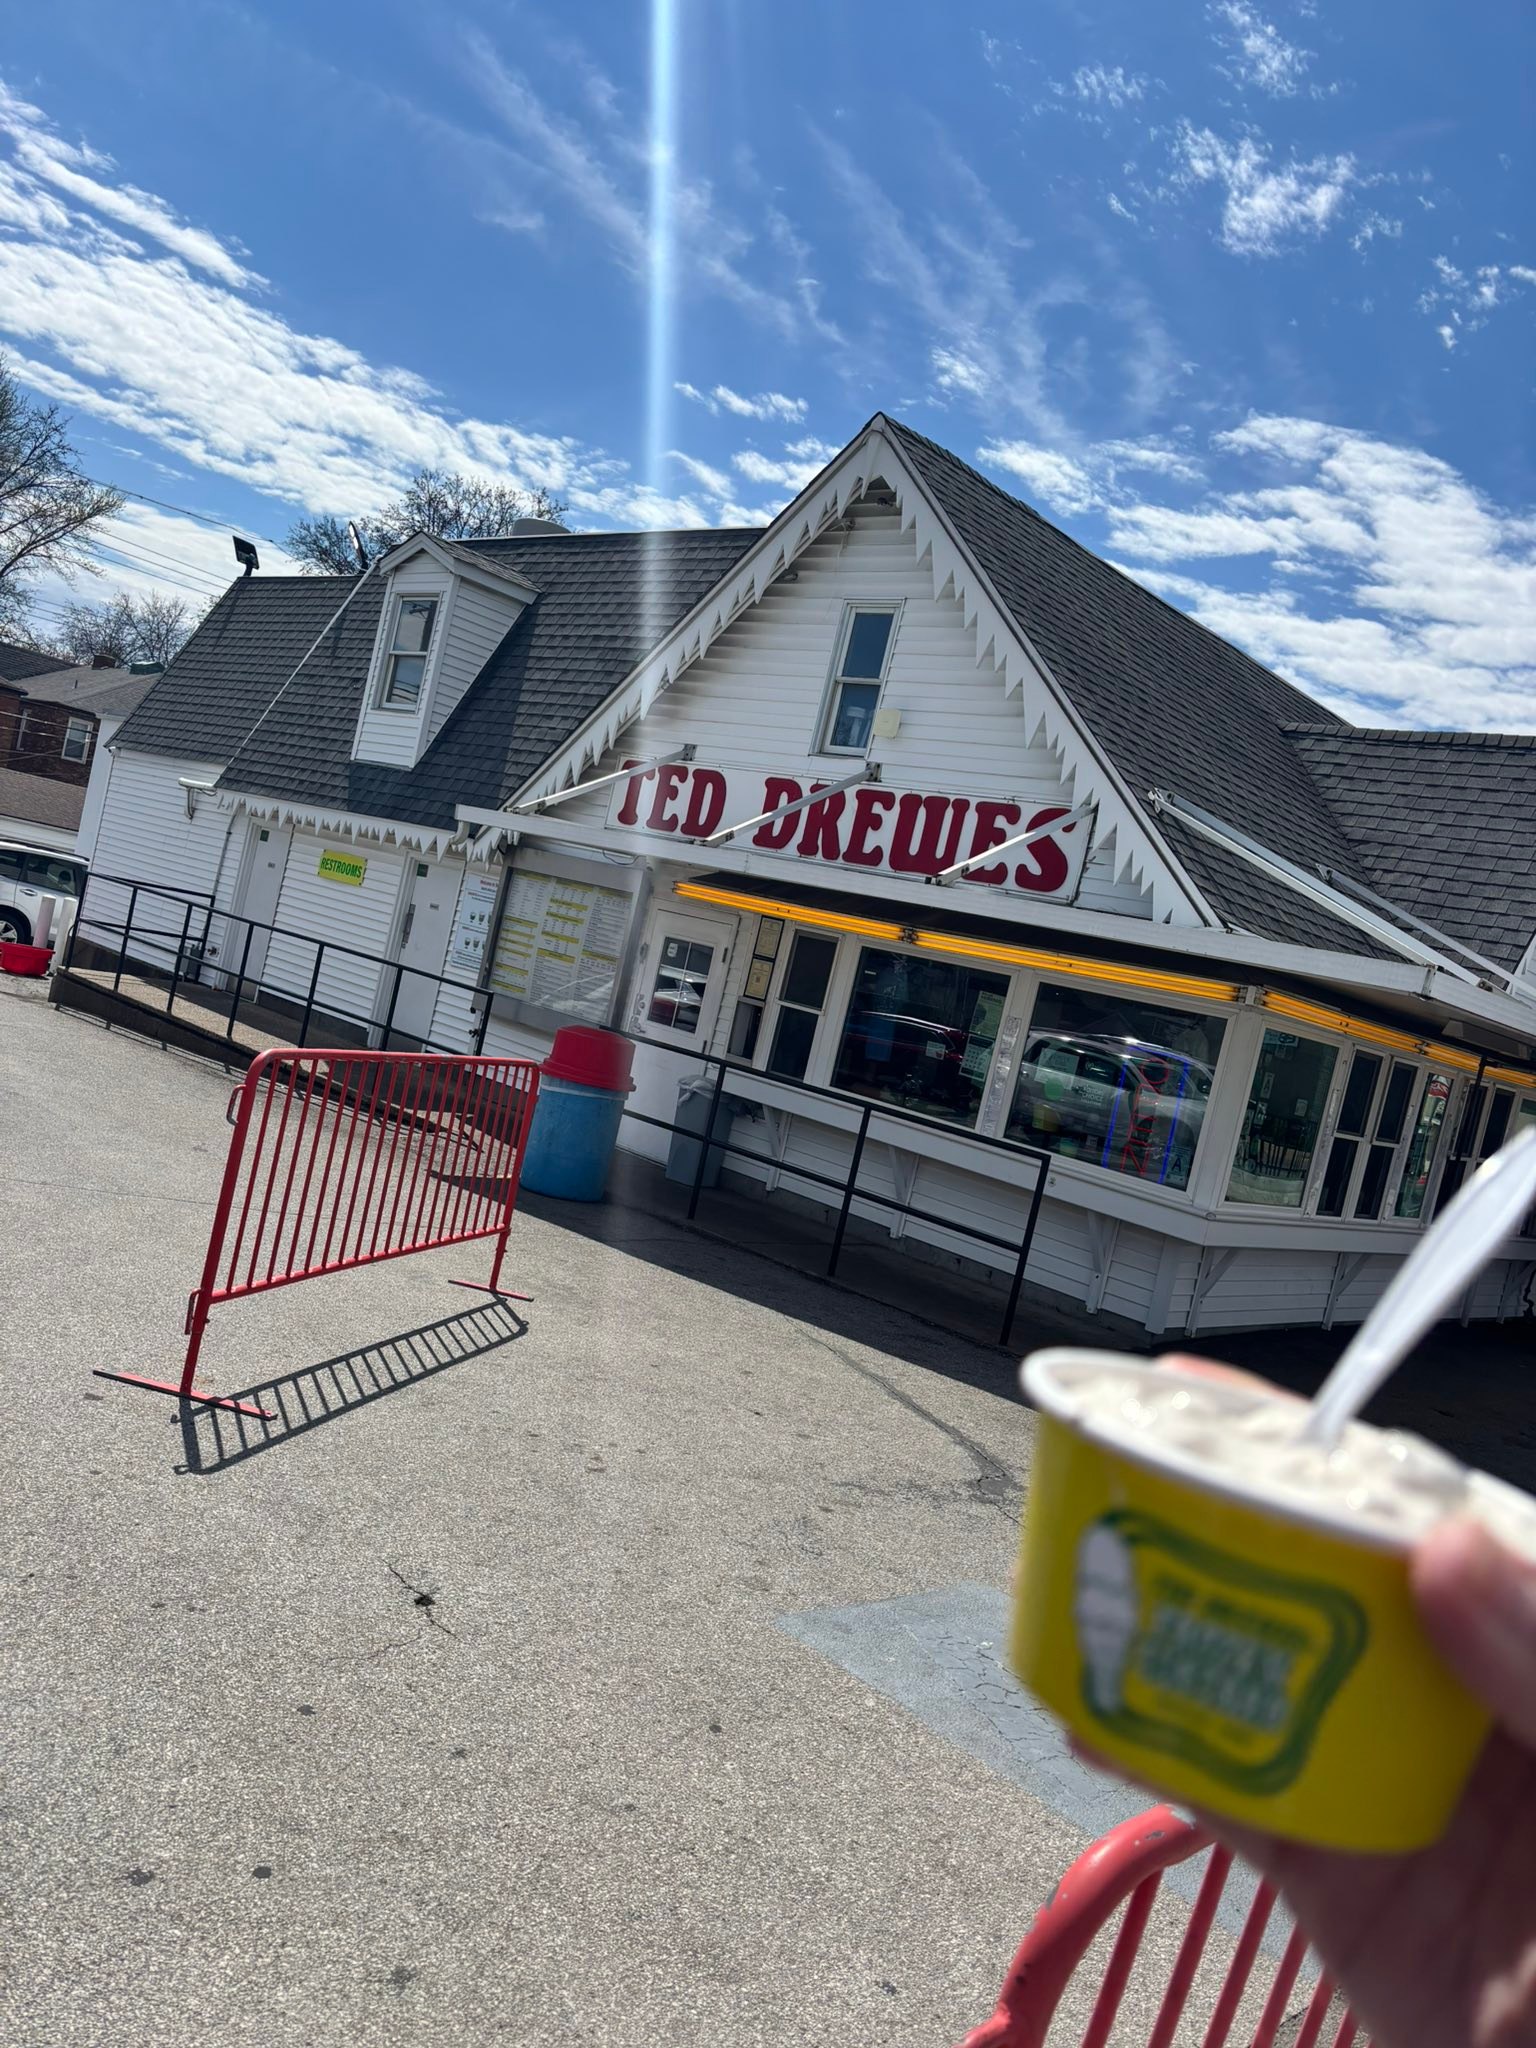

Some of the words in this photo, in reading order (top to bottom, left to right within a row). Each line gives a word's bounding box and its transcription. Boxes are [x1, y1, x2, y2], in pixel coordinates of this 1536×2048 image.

[320, 856, 363, 879] RESTROOMS
[617, 759, 727, 837] TED
[752, 776, 1077, 893] DREWES
[1120, 1057, 1169, 1175] OPEN
